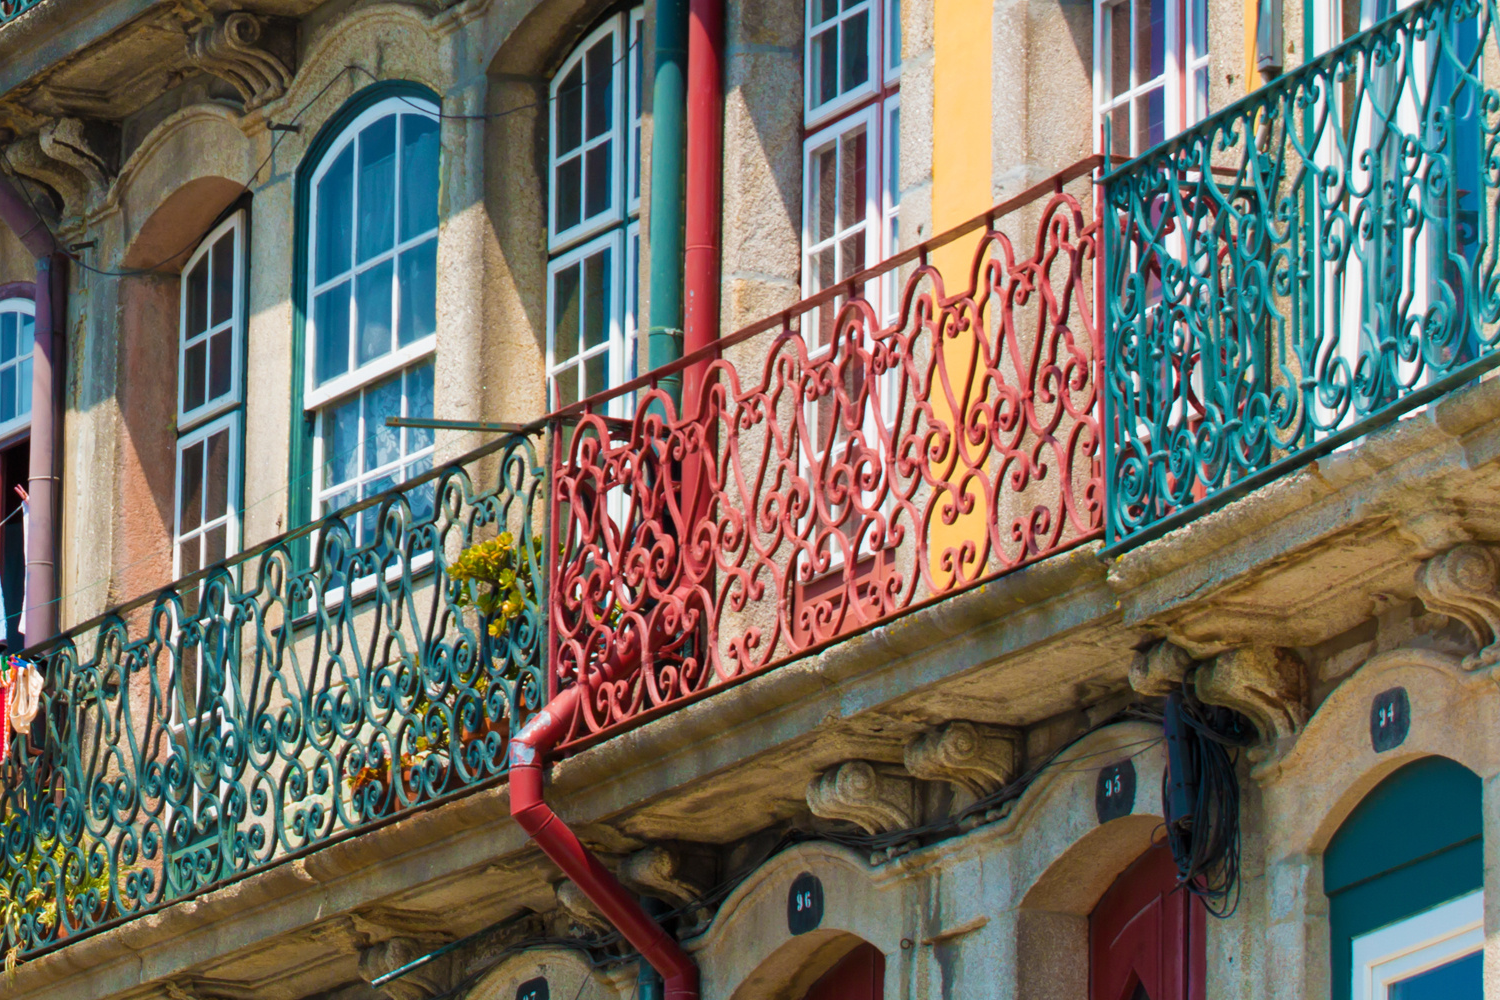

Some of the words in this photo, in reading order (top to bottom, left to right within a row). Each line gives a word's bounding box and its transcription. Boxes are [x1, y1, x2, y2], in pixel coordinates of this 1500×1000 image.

[1379, 703, 1394, 727] 94
[1105, 774, 1121, 797] 95
[796, 891, 812, 911] 96
